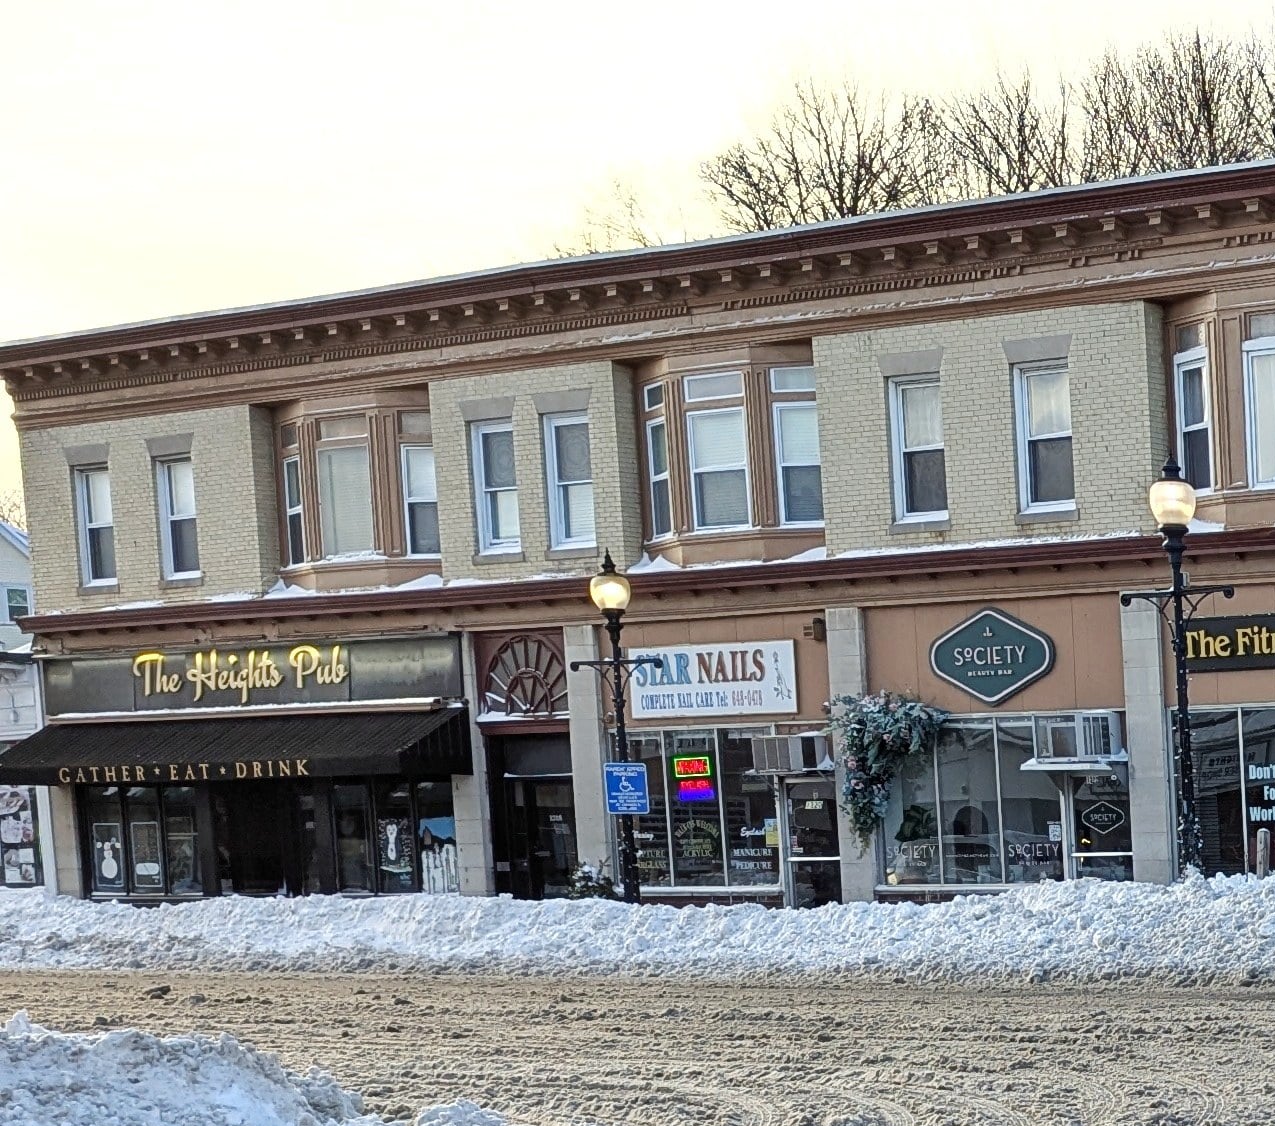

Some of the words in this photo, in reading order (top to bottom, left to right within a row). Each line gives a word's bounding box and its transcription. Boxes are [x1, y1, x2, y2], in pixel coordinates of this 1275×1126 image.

[1185, 630, 1231, 659] The
[133, 653, 182, 696] The
[186, 649, 283, 704] Heights
[289, 645, 349, 689] Pub
[635, 653, 692, 687] STAR
[696, 649, 766, 684] NAILS
[641, 693, 675, 710] COMPLETE
[695, 691, 714, 708] CARE
[59, 765, 146, 783] GATHER
[169, 763, 210, 780] EAT
[235, 759, 310, 779] DRINK
[733, 848, 773, 857] MANICURE
[735, 861, 773, 870] PEDICURE
